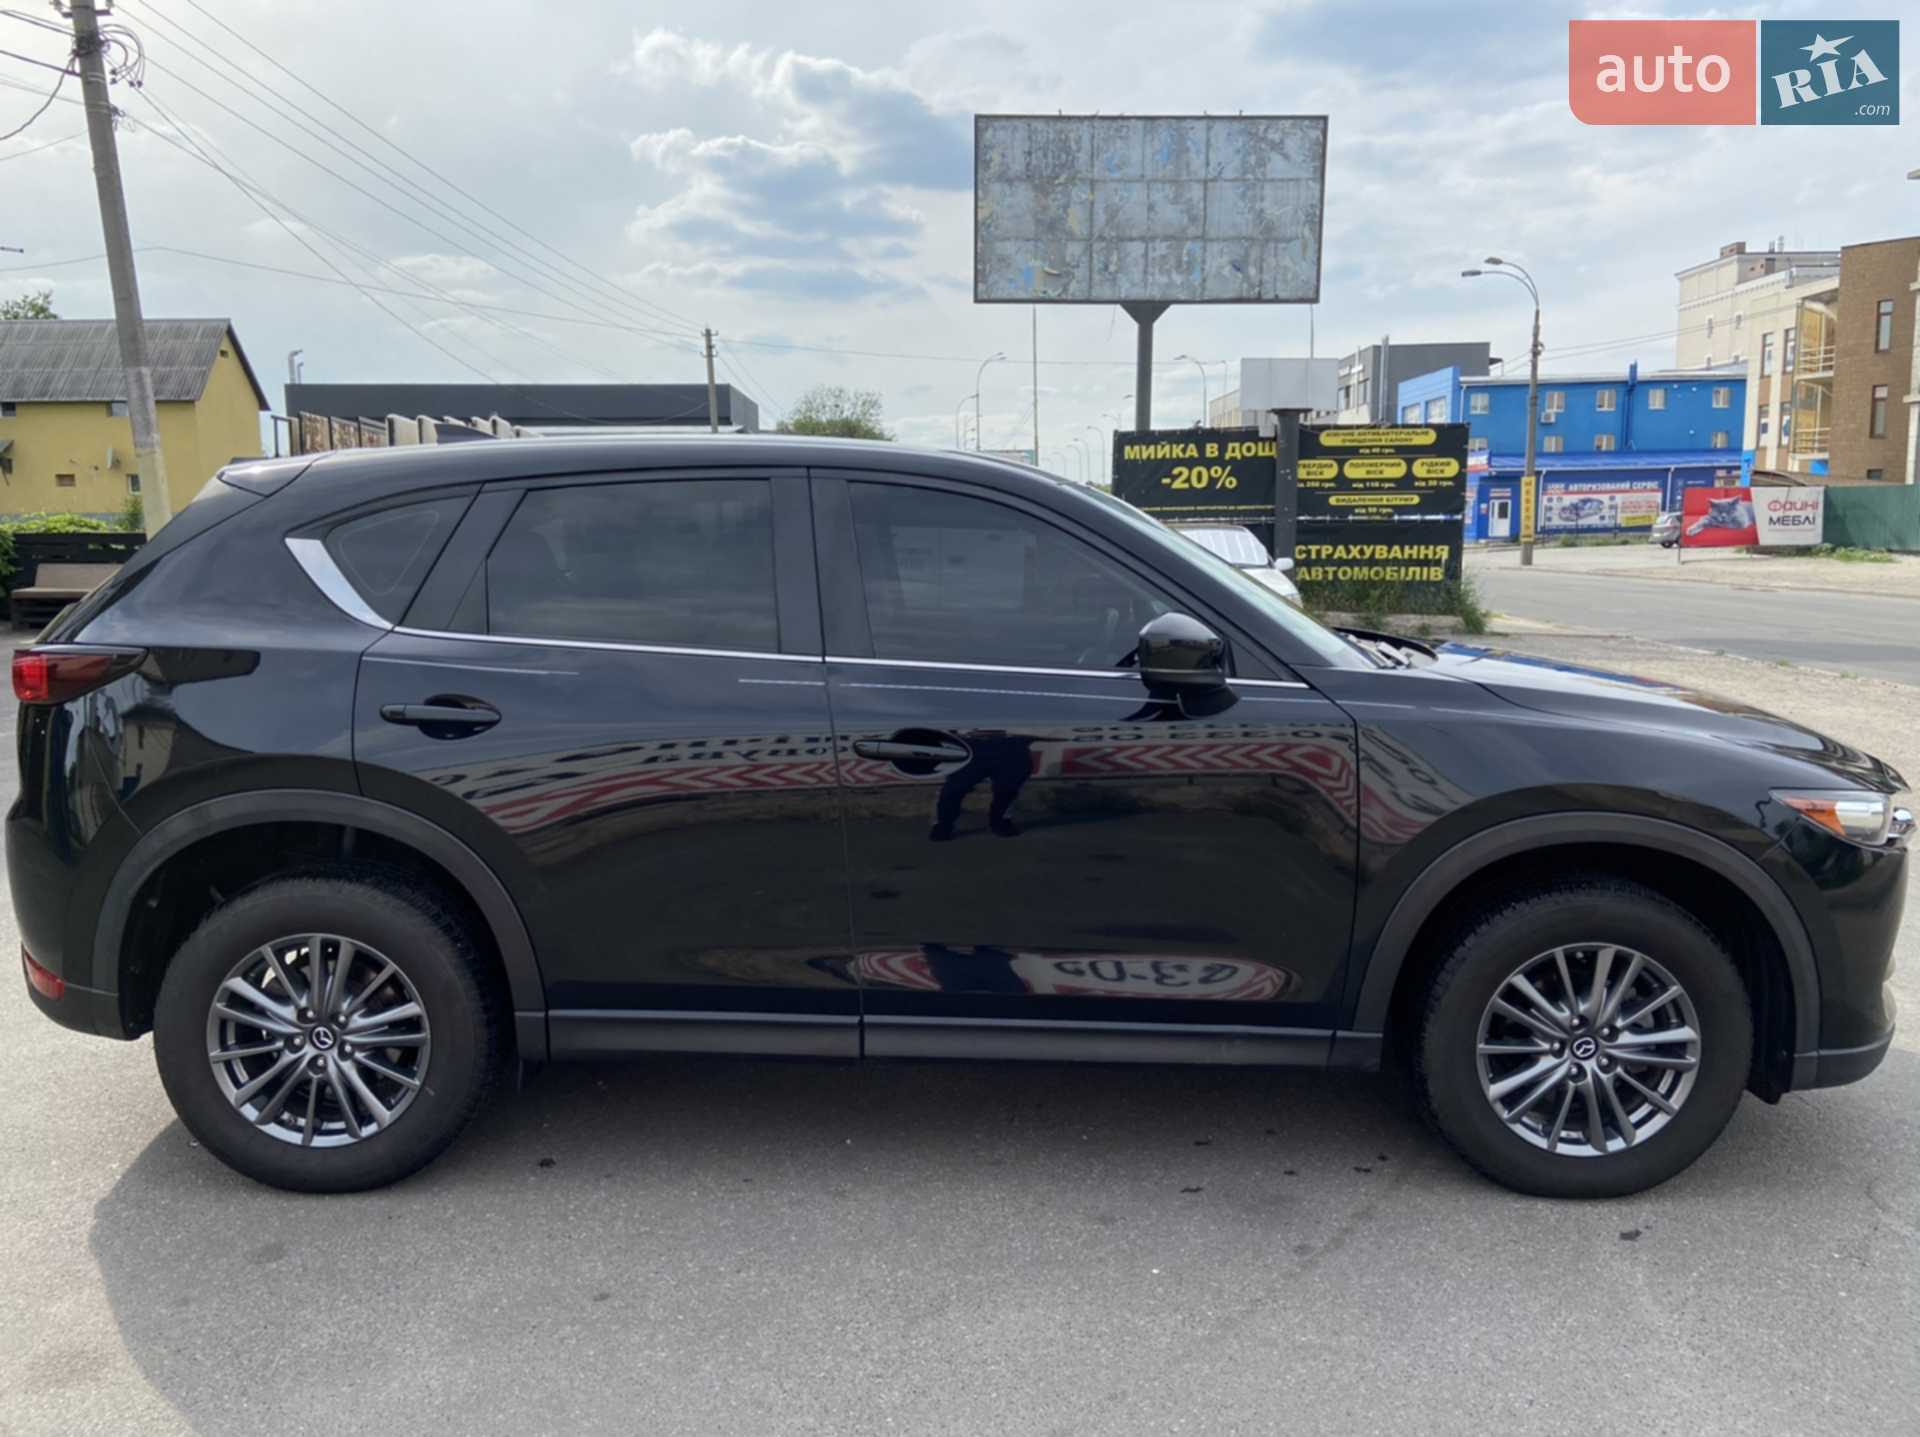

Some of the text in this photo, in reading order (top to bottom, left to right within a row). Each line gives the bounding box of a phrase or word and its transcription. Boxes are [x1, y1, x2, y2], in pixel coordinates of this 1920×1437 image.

[1124, 440, 1199, 460] МИЙКА
[1205, 443, 1219, 458] В
[1349, 461, 1402, 469] ПОЛІМЕРНИЙ
[1420, 460, 1451, 468] РІДКИЙ
[1161, 465, 1238, 490] -20%
[1335, 496, 1384, 504] ВИДАЛЕННЯ
[1768, 512, 1816, 526] МЕБЛІ
[1295, 545, 1449, 560] СТРАХУВАННЯ
[1296, 566, 1444, 581] АВТОМОБІЛІВ
